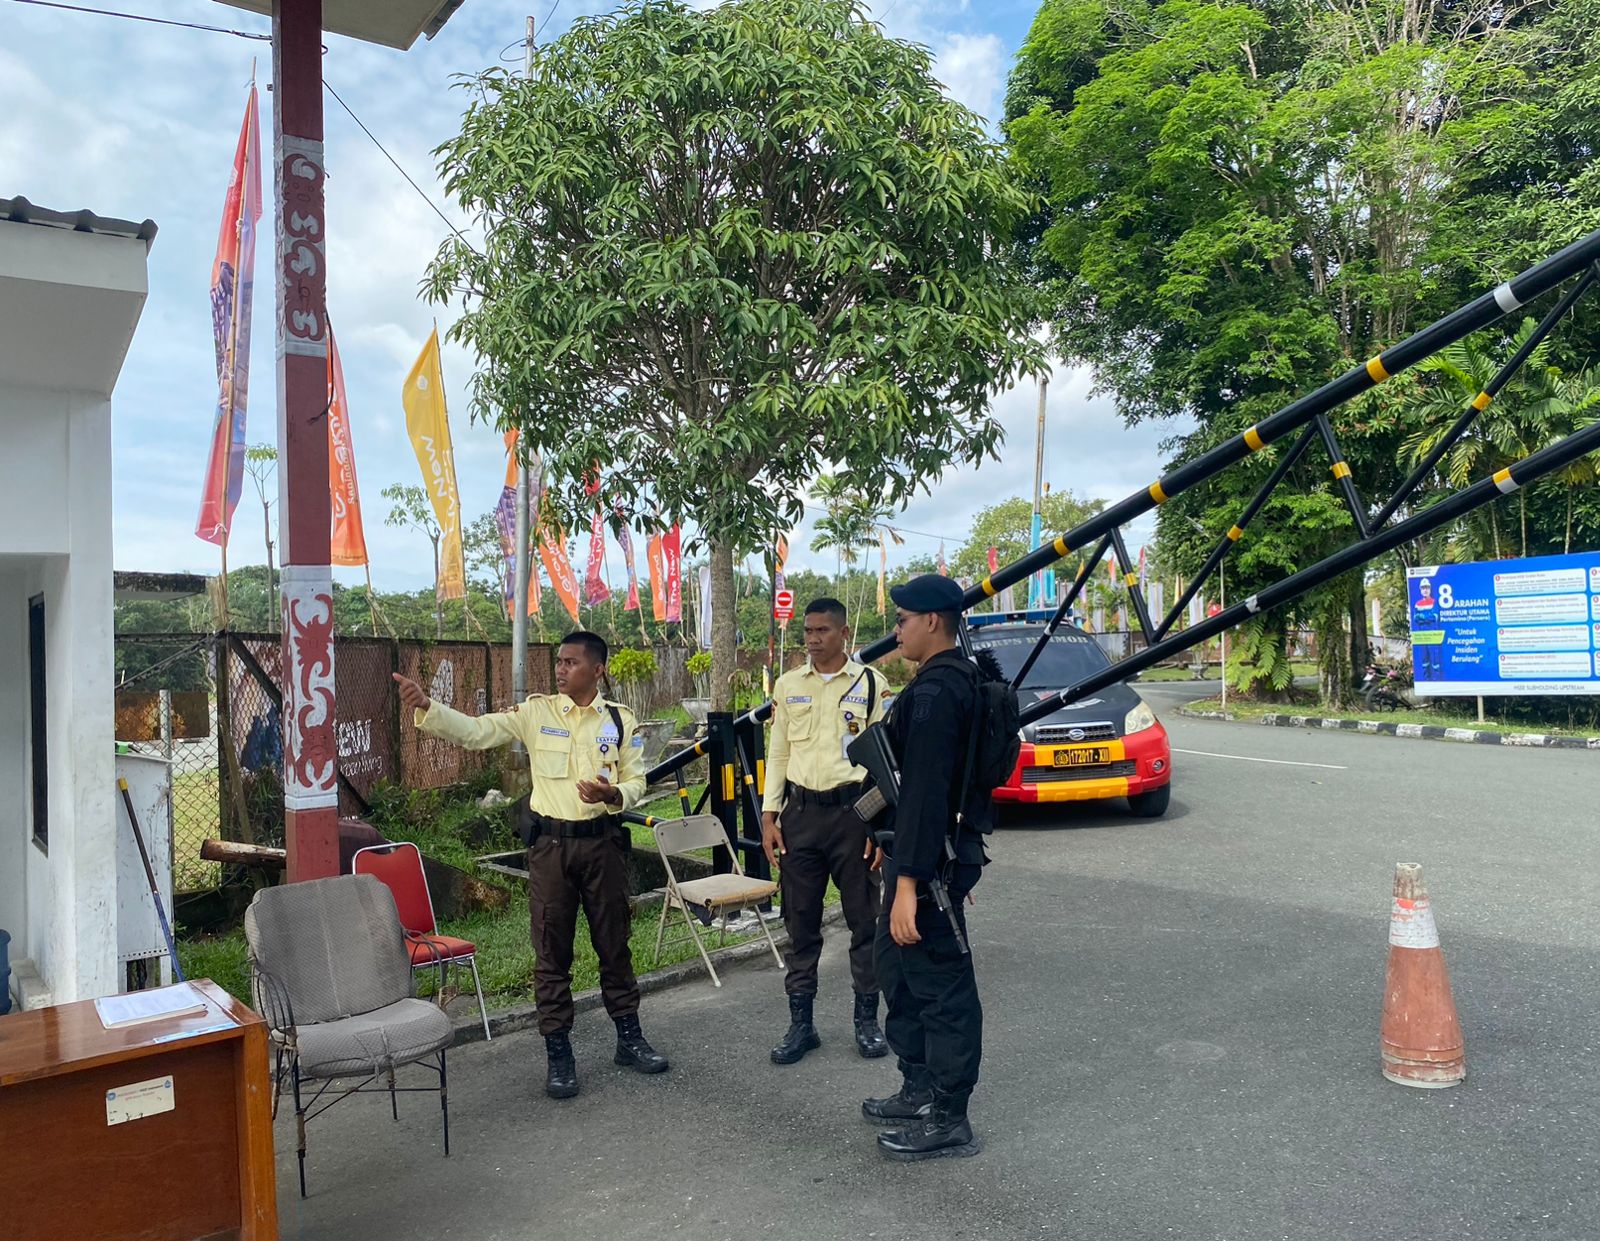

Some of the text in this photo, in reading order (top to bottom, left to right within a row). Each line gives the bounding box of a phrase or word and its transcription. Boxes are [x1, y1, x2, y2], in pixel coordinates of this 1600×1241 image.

[1438, 584, 1489, 609] 8 ARAHAN
[1440, 608, 1490, 617] DIREKTUR UTAMA
[972, 635, 1088, 650] KORPS BRMOB
[1447, 637, 1486, 647] Pencegahan
